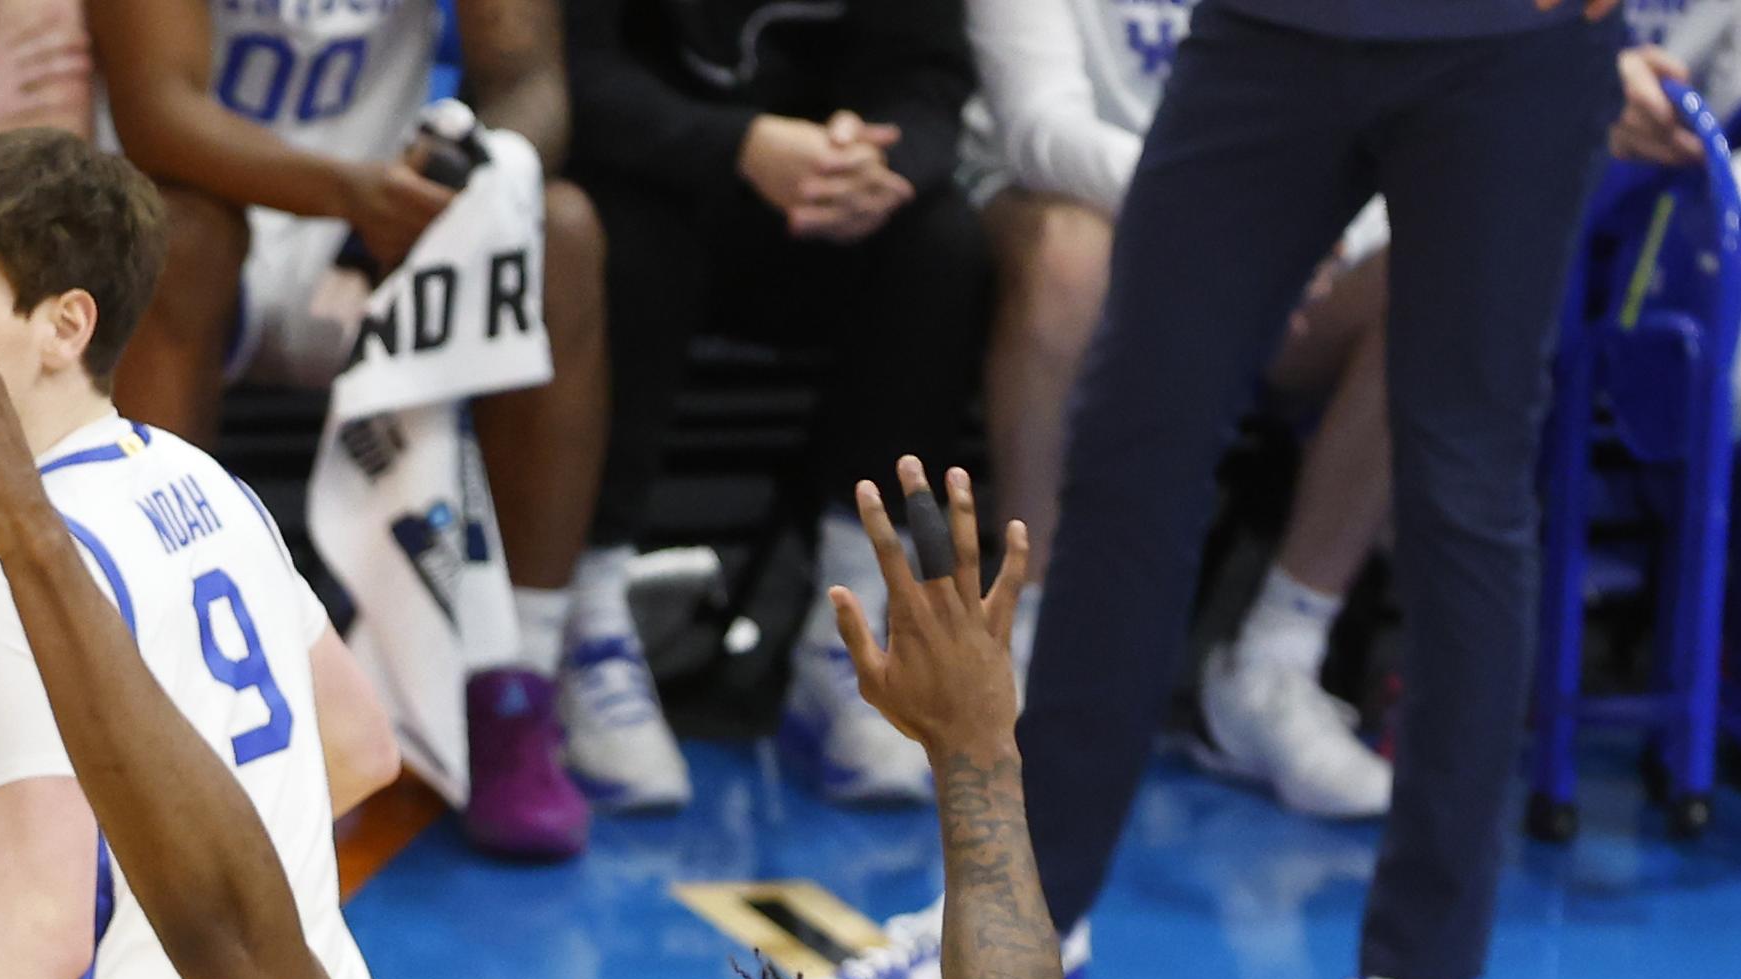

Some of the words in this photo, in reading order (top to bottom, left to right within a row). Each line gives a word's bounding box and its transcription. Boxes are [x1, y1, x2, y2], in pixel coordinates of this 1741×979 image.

[218, 33, 367, 121] 00
[136, 473, 222, 554] NOAH
[193, 568, 293, 767] 9
